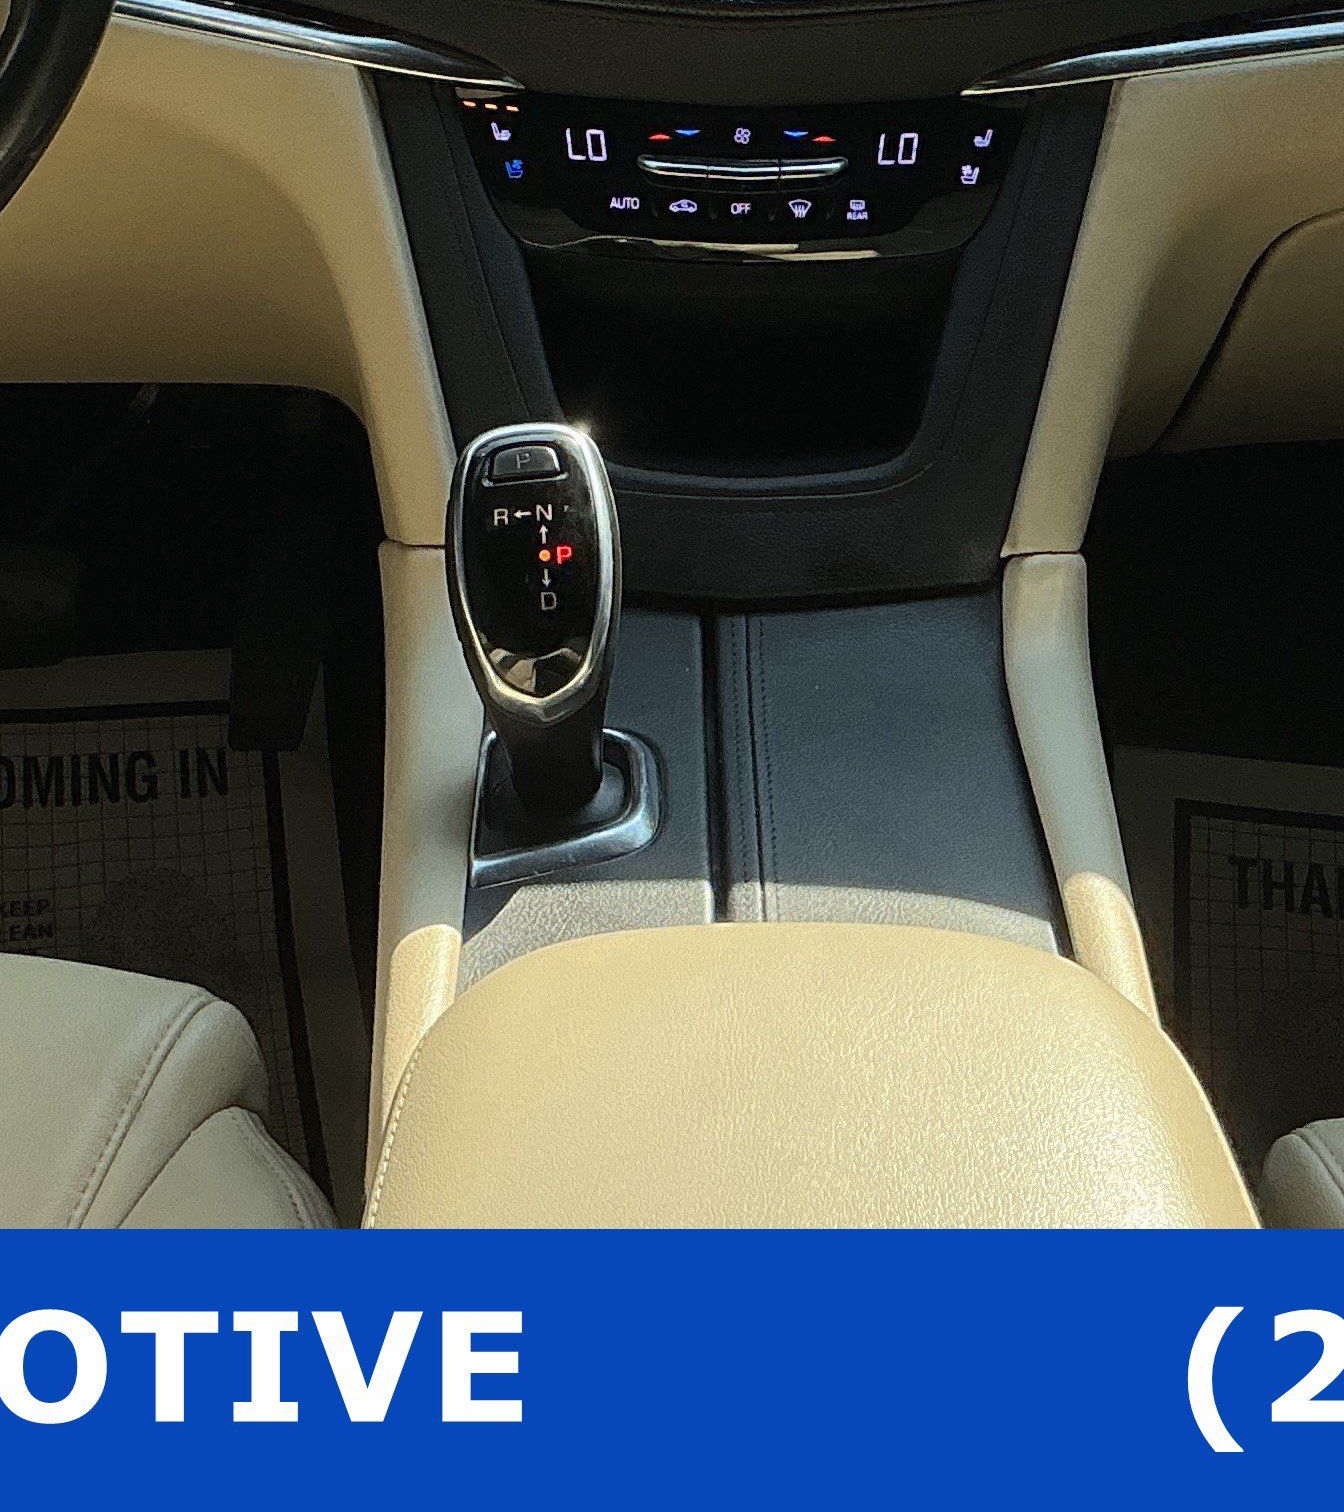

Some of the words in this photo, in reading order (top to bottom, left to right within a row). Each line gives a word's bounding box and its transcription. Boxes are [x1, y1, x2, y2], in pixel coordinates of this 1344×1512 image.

[564, 127, 608, 163] LO
[877, 131, 919, 167] LO
[609, 196, 640, 211] AUTO
[730, 202, 752, 216] OFF
[846, 211, 868, 221] REAR
[493, 507, 510, 526] R
[535, 504, 553, 523] N
[556, 545, 573, 565] P
[540, 592, 558, 612] D
[179, 747, 231, 799] IN
